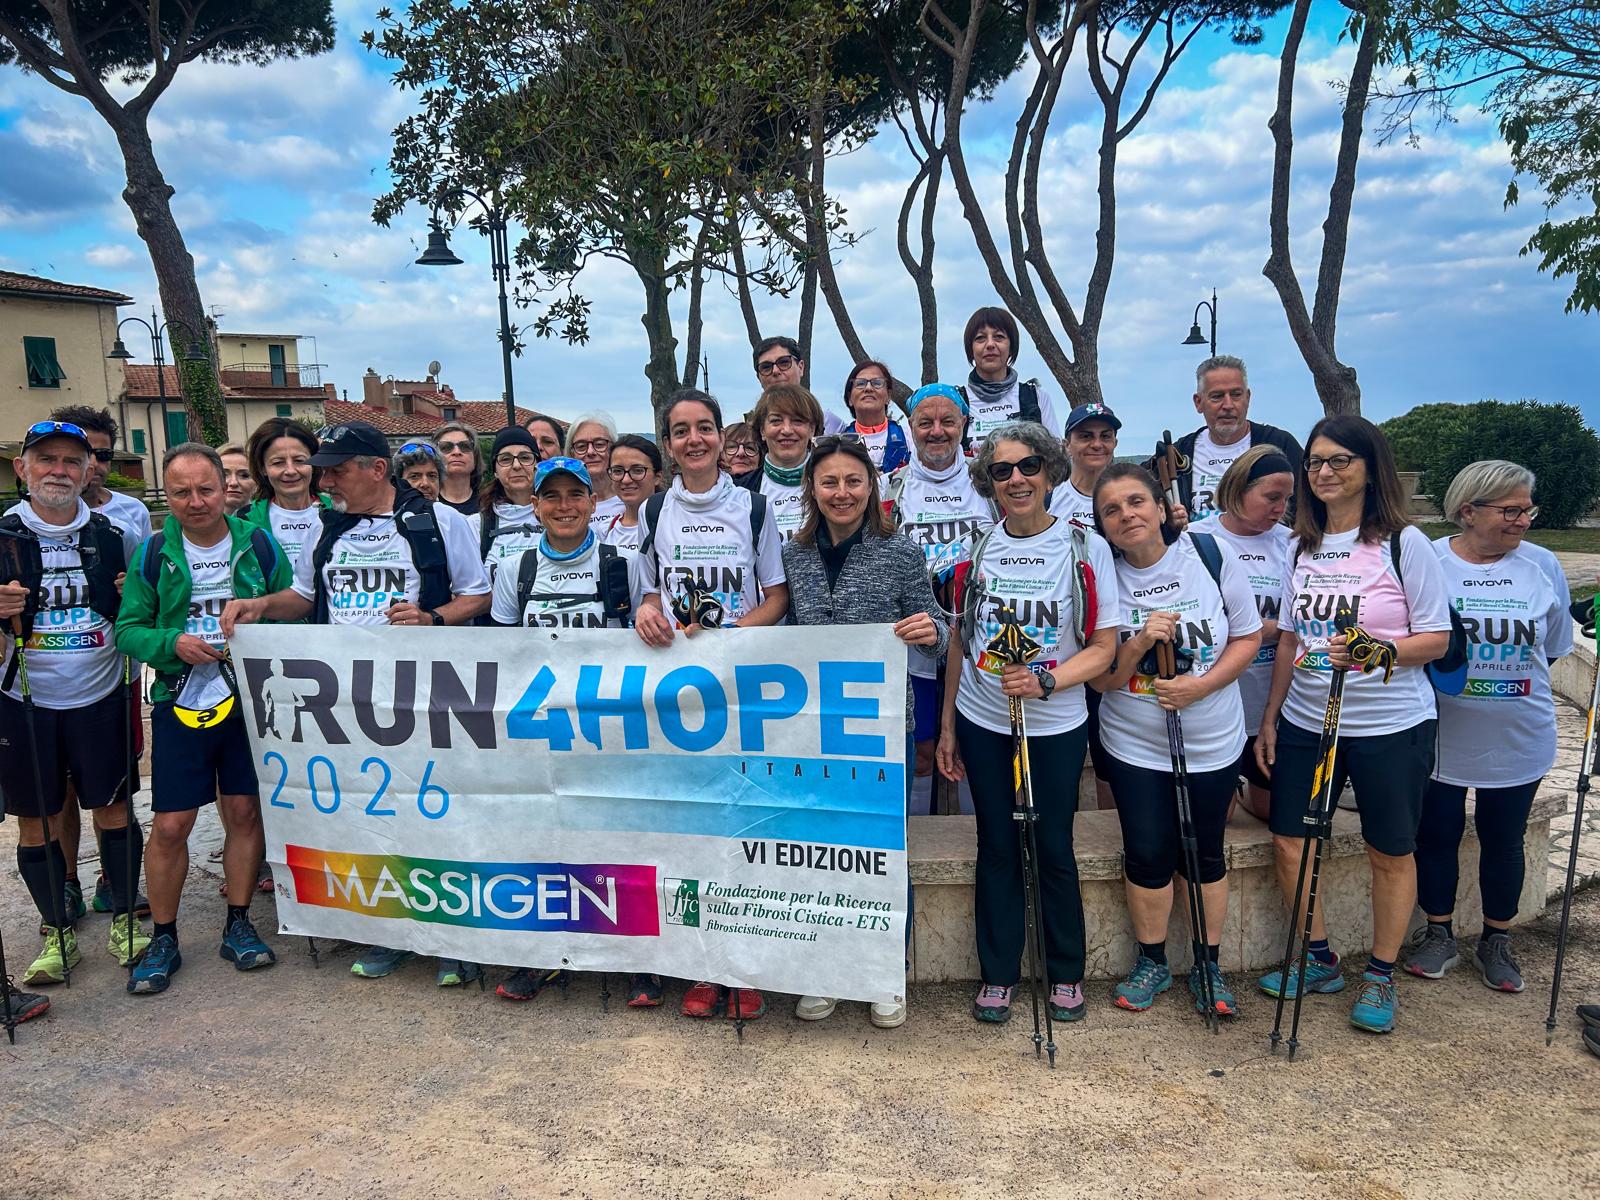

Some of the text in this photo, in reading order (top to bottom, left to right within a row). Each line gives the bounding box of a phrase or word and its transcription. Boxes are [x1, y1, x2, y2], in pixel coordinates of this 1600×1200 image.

[979, 404, 1013, 414] GIVOVA
[1208, 458, 1238, 466] GIVOV
[924, 495, 962, 503] GIVOVA
[281, 522, 312, 531] GIVOV
[681, 525, 725, 533] GIVOVA
[1000, 557, 1045, 566] GIVOVA
[1312, 551, 1351, 560] GIVOVA
[327, 568, 406, 593] RUN
[551, 571, 594, 582] GIVOVA
[1463, 579, 1513, 587] GIVOVA
[1133, 581, 1181, 598] GIVOVA
[1461, 617, 1536, 646] RUN
[1474, 663, 1512, 671] APRILE
[1465, 682, 1526, 694] ASSIGEN
[741, 761, 887, 782] ITALIA
[263, 751, 450, 820] 2026
[742, 841, 887, 876] VI EDIZIONE
[667, 883, 699, 917] ffc
[704, 881, 892, 912] Fondazione per la Ricerca
[706, 902, 739, 916] sulla
[742, 903, 791, 921] Fibrosi
[794, 908, 844, 927] Cistica
[856, 914, 891, 932] ETS
[705, 919, 818, 942] fibrosicisticaricerca.it
